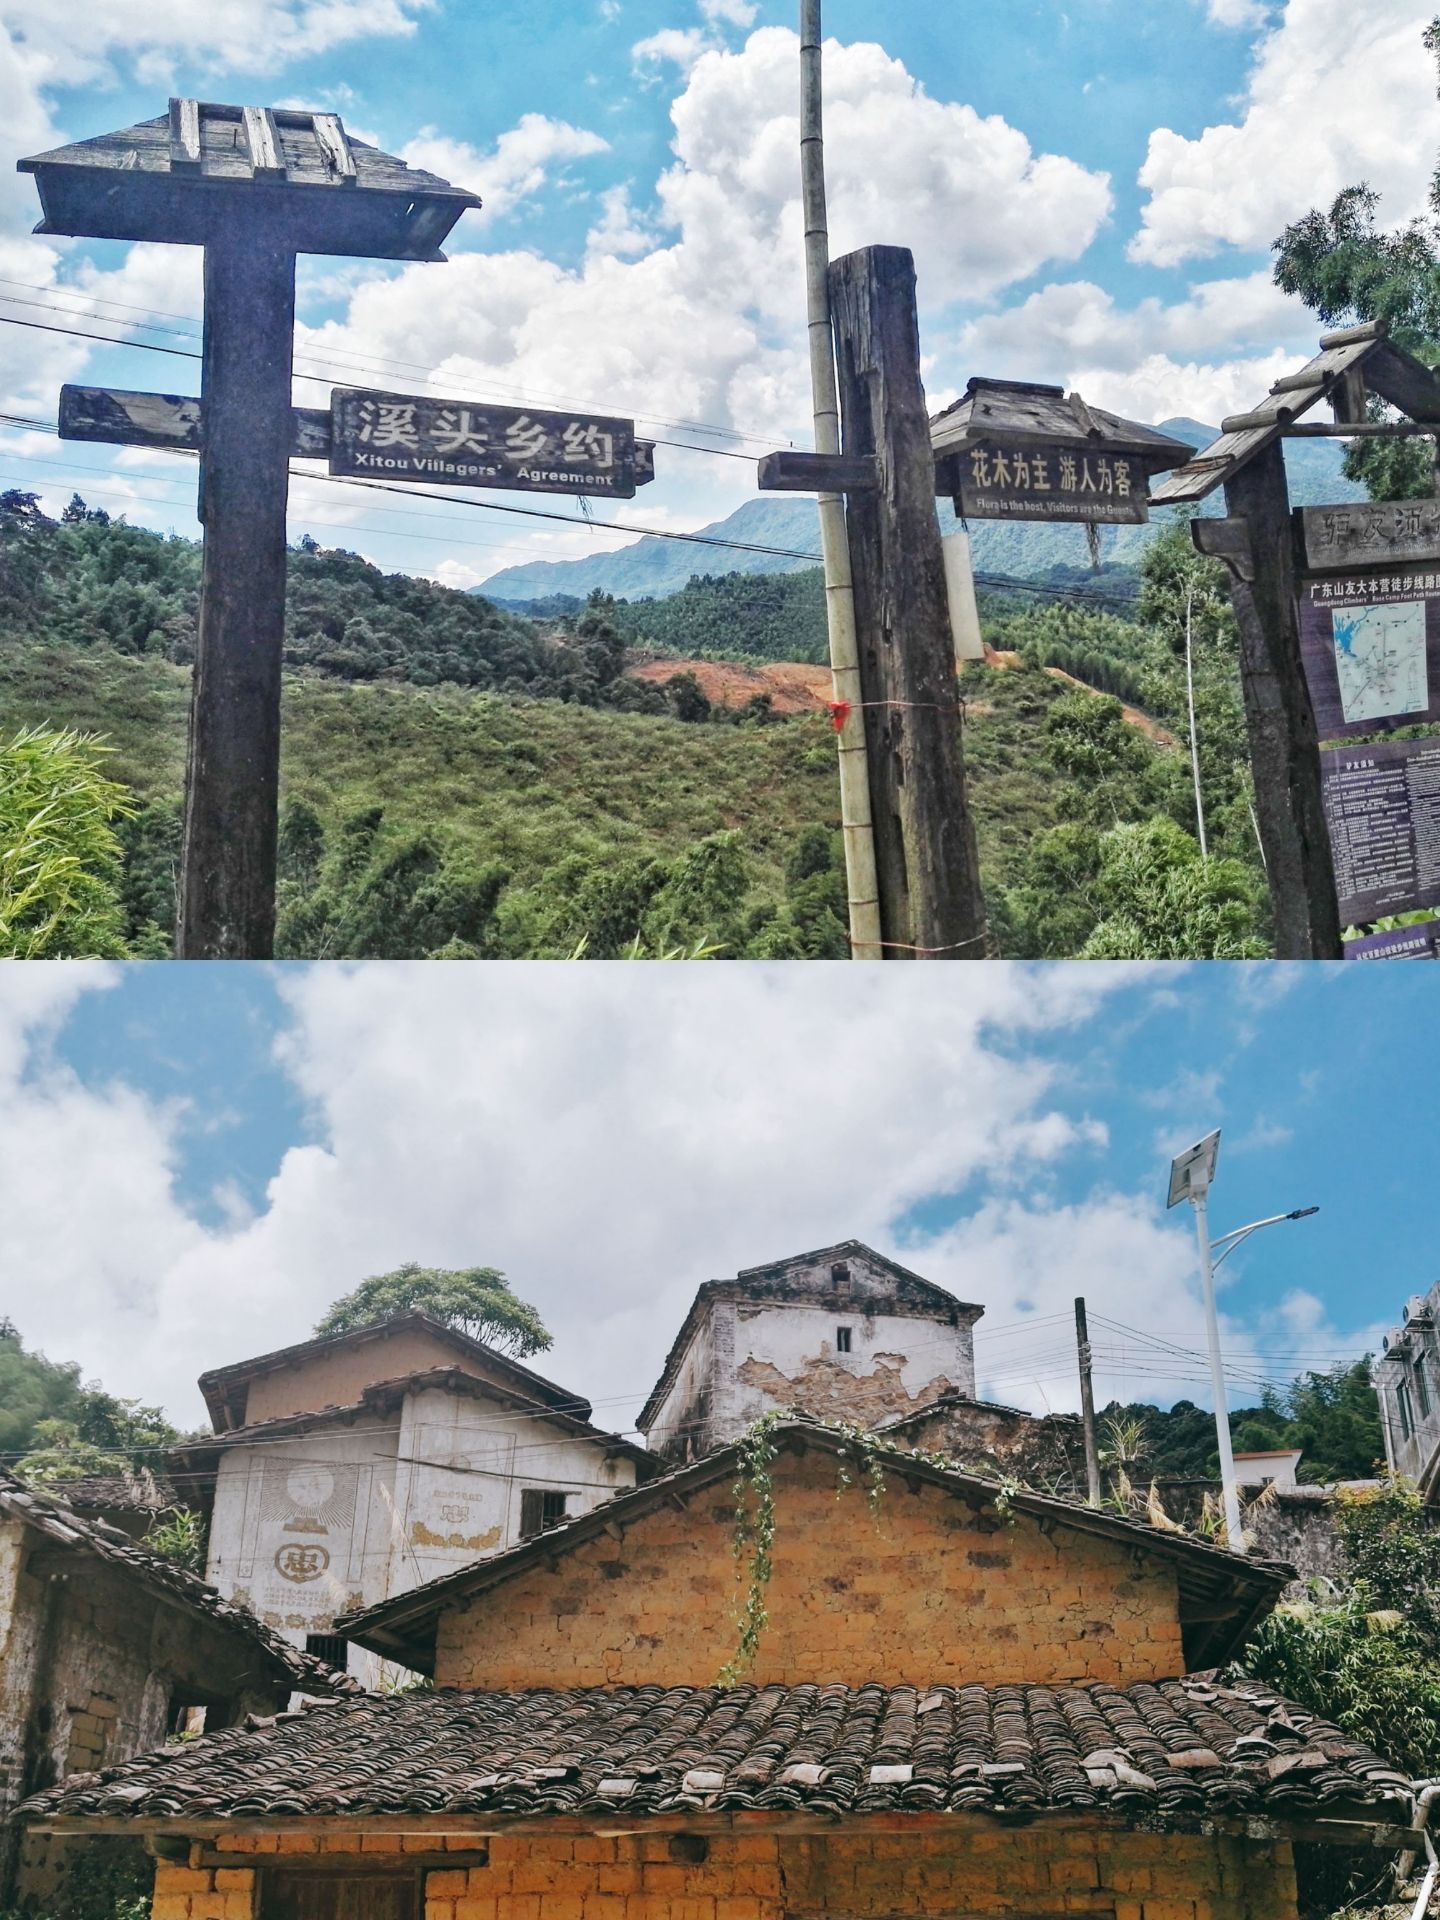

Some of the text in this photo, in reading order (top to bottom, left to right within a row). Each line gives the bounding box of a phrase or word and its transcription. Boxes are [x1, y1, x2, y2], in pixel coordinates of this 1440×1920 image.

[358, 400, 614, 468] 溪头乡约
[355, 453, 408, 469] Xitou
[517, 467, 613, 485] Agreement
[970, 449, 1132, 497] 花木为主 游人为客
[1008, 500, 1023, 511] the
[1046, 502, 1078, 513] Visitors
